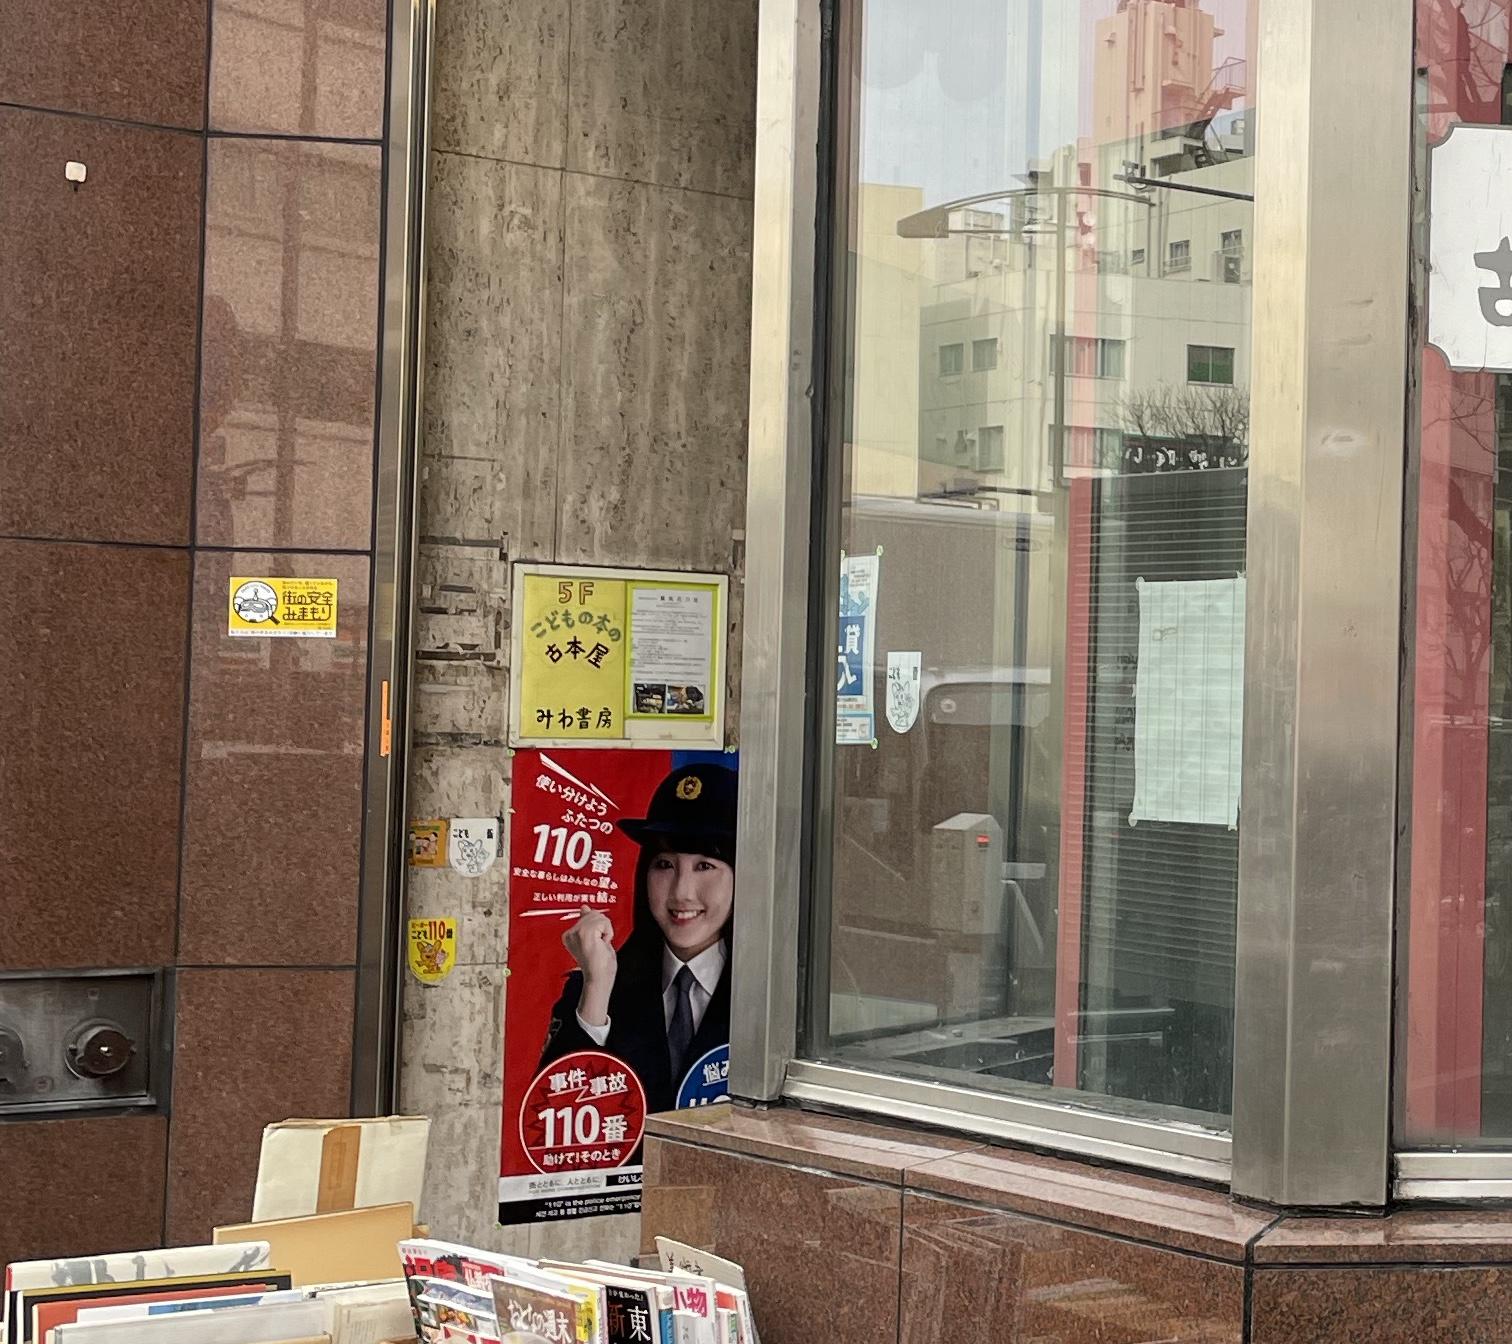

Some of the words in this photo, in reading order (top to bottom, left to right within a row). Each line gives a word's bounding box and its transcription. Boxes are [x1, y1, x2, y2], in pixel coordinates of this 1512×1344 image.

[558, 581, 594, 605] 5F
[283, 606, 331, 621] みまもり
[530, 609, 621, 642] こどもの本の
[545, 636, 609, 669] 古本屋
[536, 707, 612, 730] みわ書房
[536, 774, 607, 816] 使い分けよう
[561, 808, 614, 835] ふたつの
[533, 823, 614, 874] 110番
[549, 1068, 587, 1092] 事件
[589, 1071, 627, 1096] 事故
[538, 1104, 628, 1148] 110番
[617, 1174, 642, 1184] けいし
[507, 1298, 573, 1344] おとなの週末
